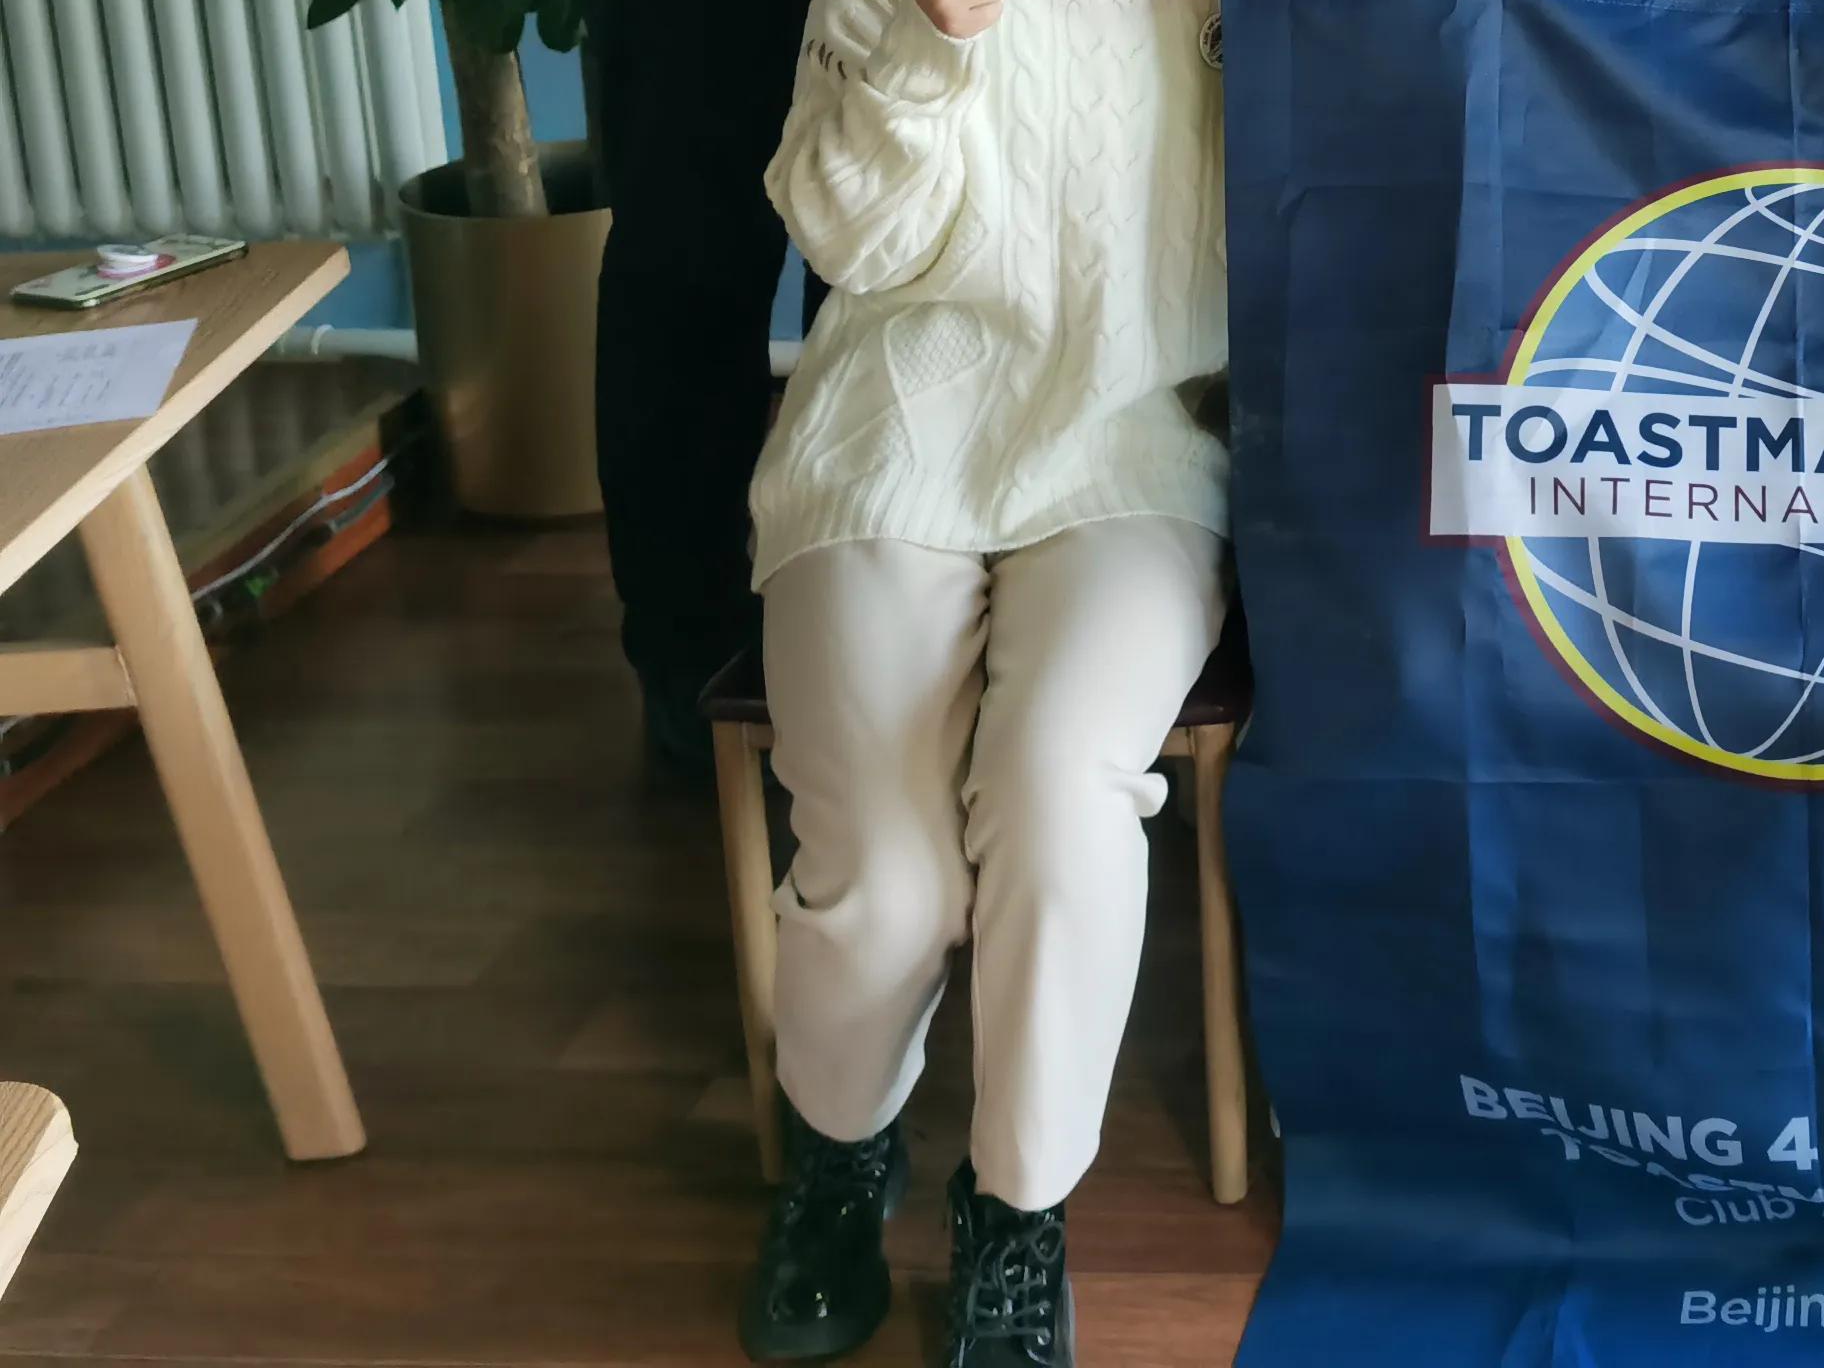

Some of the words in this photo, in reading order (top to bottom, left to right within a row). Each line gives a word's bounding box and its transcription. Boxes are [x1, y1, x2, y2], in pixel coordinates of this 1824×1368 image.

[1460, 1074, 1744, 1166] BEIJING
[1767, 1117, 1819, 1170] 4
[1675, 1192, 1796, 1225] Club
